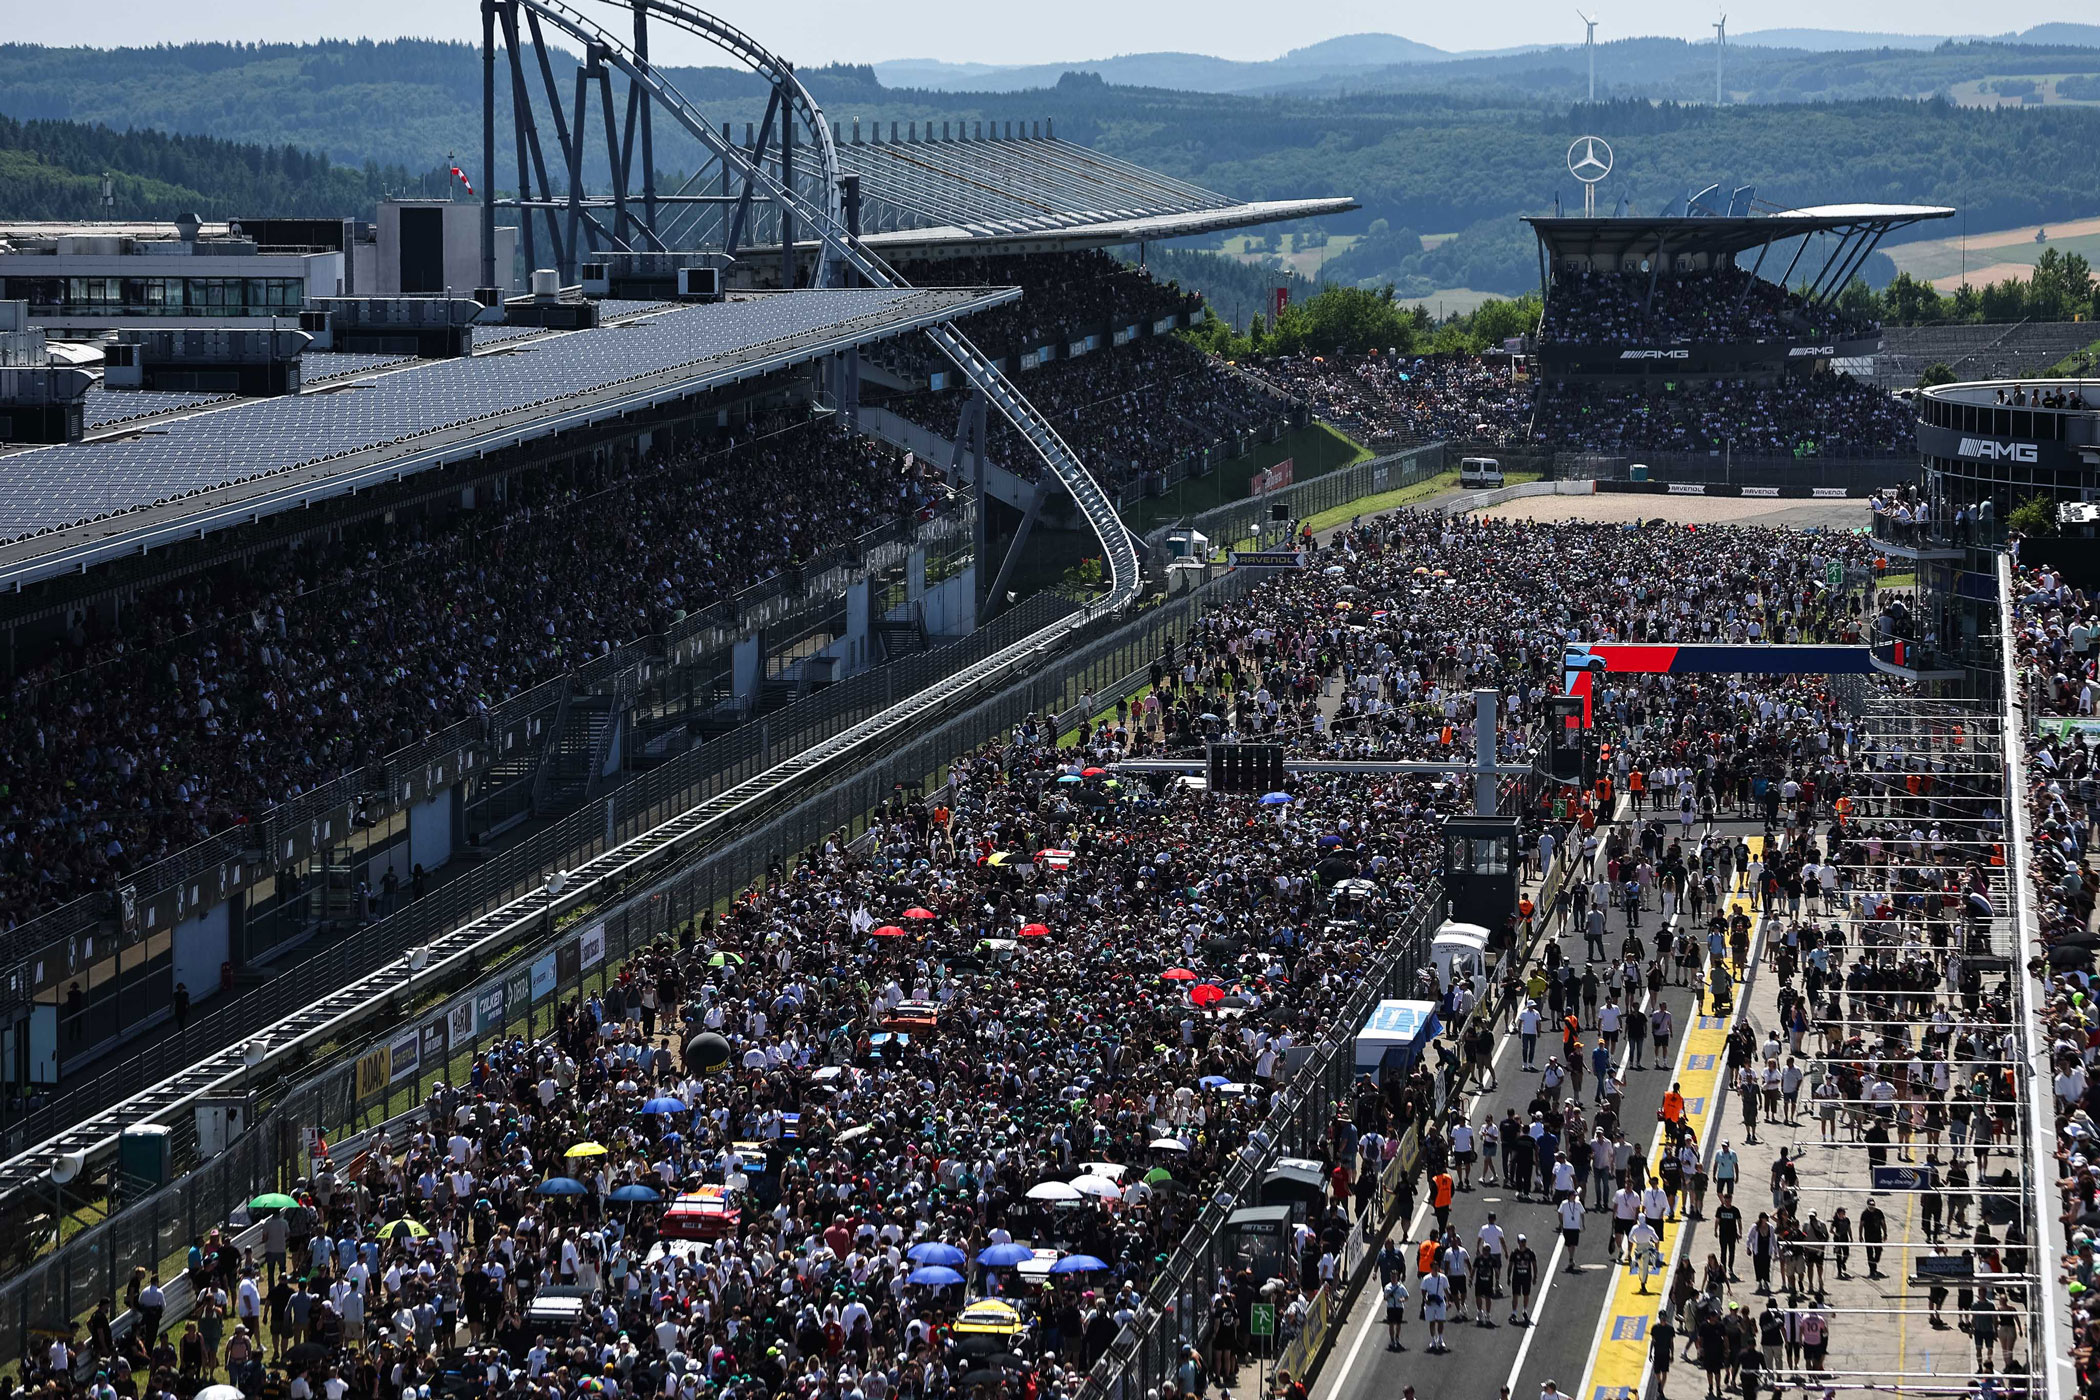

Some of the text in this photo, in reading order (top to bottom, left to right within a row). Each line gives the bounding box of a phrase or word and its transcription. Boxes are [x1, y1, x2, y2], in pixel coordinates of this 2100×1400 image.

[1643, 350, 1689, 359] AMG
[1805, 346, 1834, 356] AMG
[1979, 440, 2038, 462] AMG
[1671, 485, 1702, 493] RAVENOL
[1744, 488, 1777, 496] RAVENOL
[1240, 556, 1294, 564] RAVENOL
[513, 976, 529, 1004] DEKRA
[480, 989, 503, 1014] FALKEN
[362, 1051, 385, 1096] ADAC
[1806, 1322, 1818, 1332] 10
